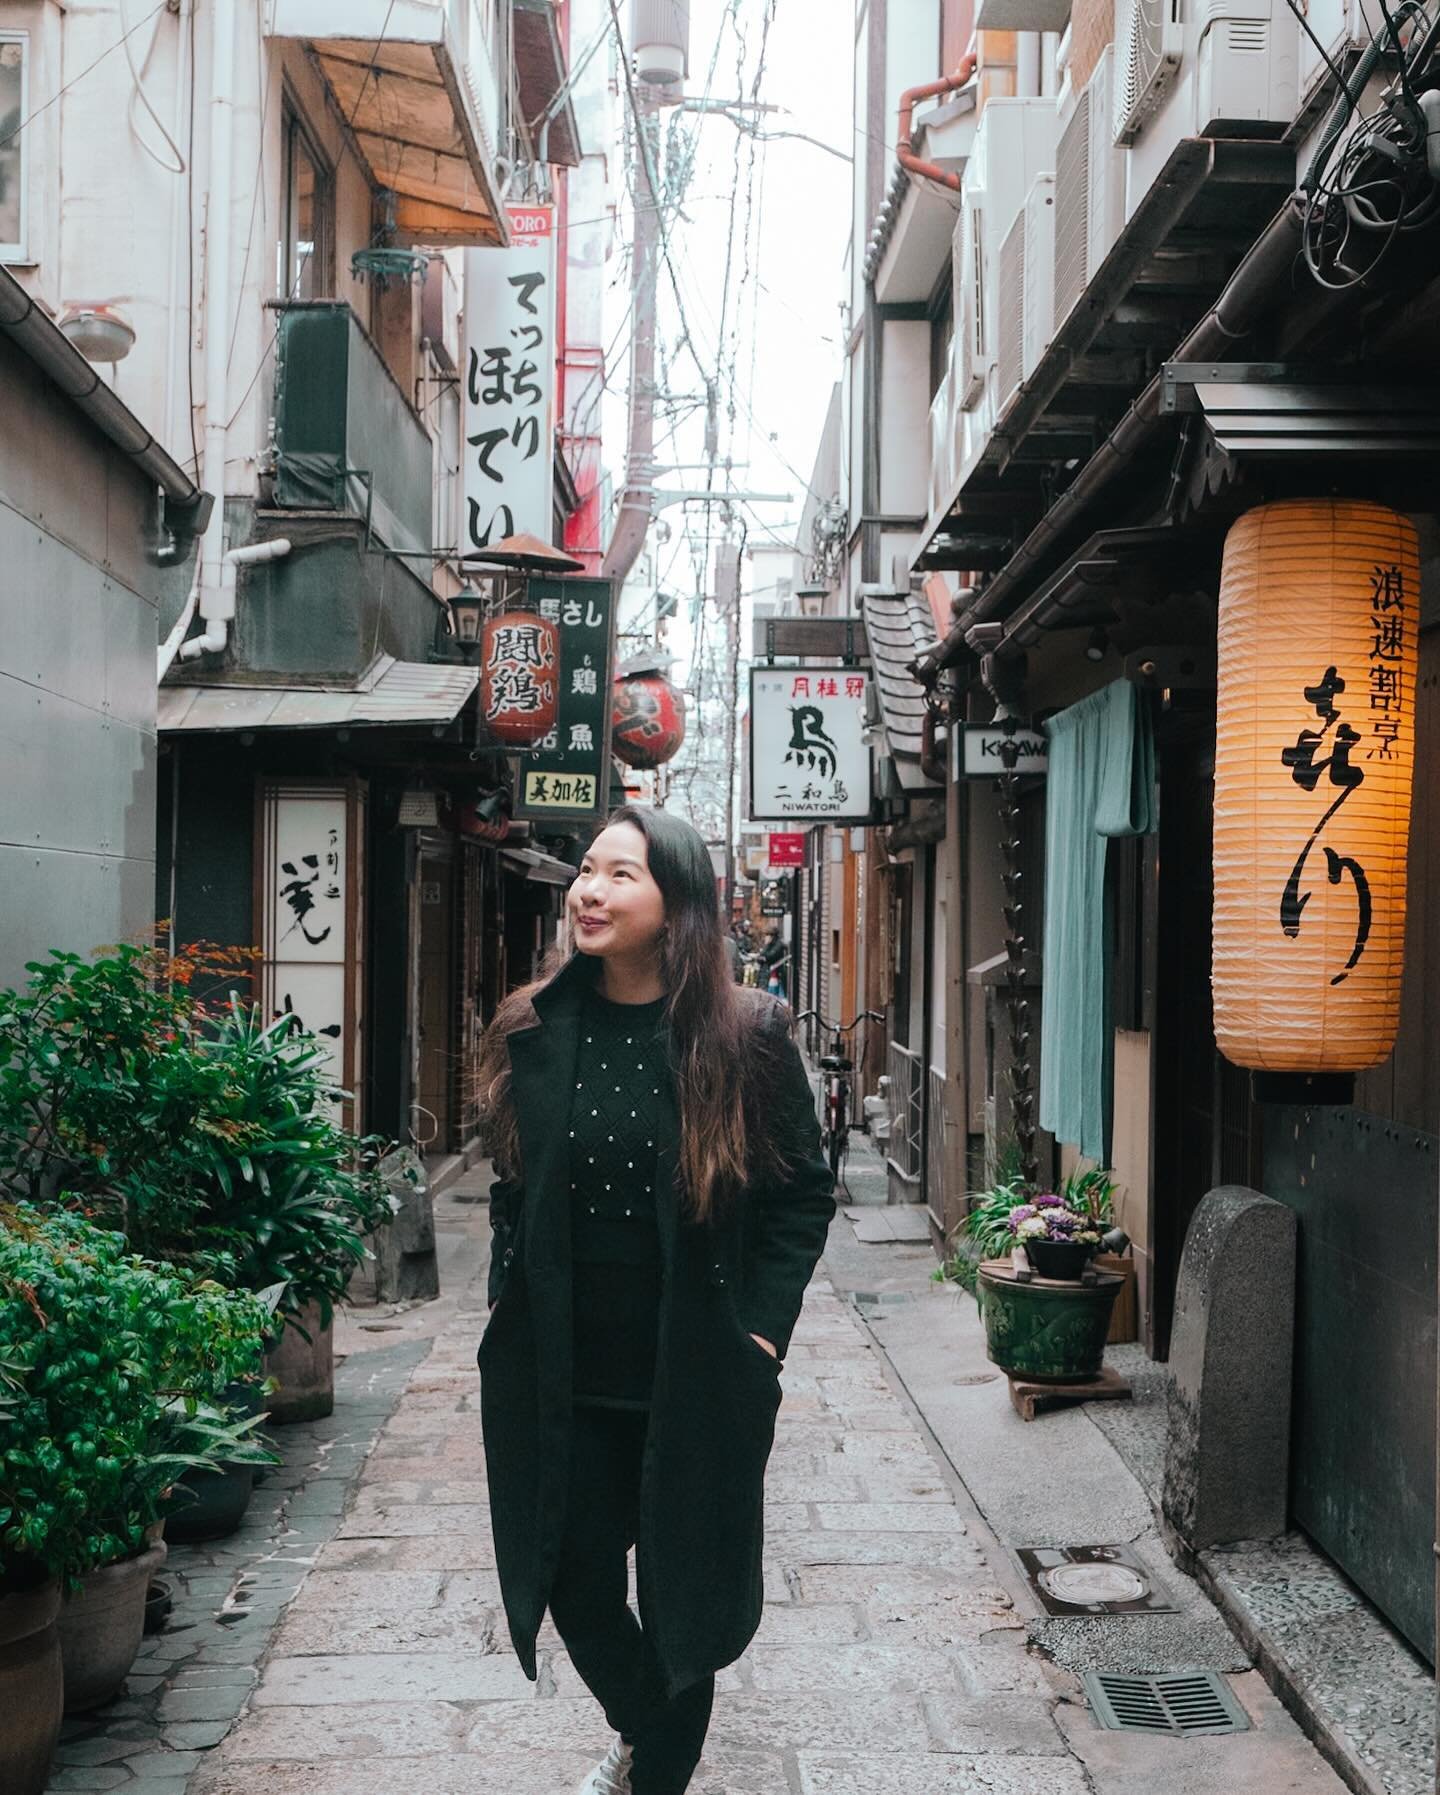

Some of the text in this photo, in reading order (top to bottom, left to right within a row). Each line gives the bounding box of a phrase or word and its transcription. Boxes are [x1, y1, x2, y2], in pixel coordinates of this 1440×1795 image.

[467, 346, 514, 548] ほてい
[507, 272, 546, 461] てっちり
[539, 598, 602, 627] 馬さし
[1366, 565, 1405, 760] 浪速割烹
[782, 803, 841, 812] NIWATORI
